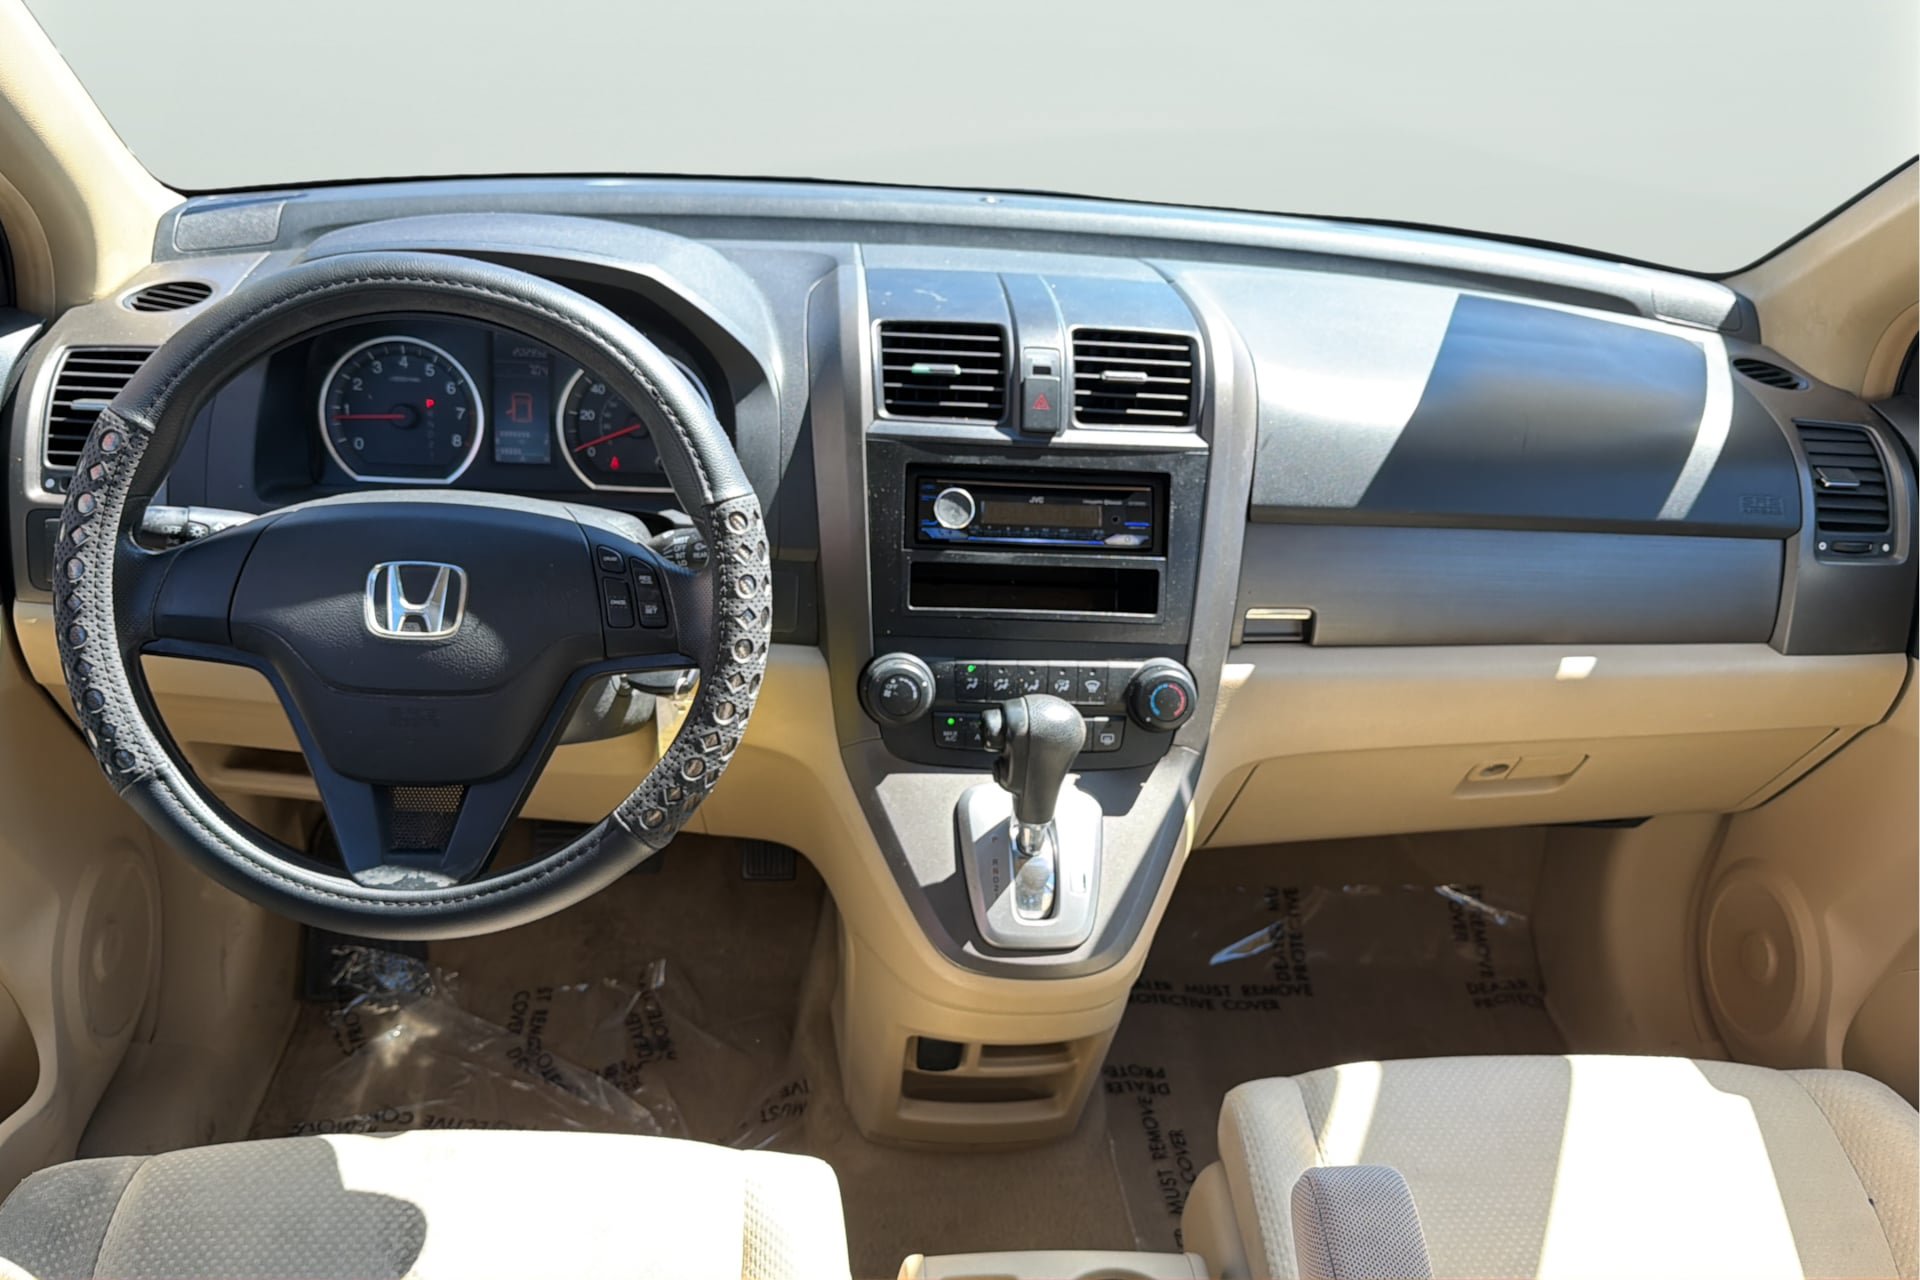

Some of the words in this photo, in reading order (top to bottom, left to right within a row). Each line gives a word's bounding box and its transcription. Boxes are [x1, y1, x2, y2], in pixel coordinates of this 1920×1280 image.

[371, 361, 382, 374] 3
[398, 356, 408, 368] 4
[424, 363, 435, 377] 5
[352, 378, 363, 391] 2
[445, 382, 457, 395] 6
[456, 407, 465, 420] 7
[580, 410, 595, 420] 20
[354, 437, 364, 450] 0
[451, 434, 462, 448] 8
[1028, 496, 1045, 504] JVC
[1184, 983, 1231, 997] MUST
[1240, 983, 1313, 998] REMOVE
[1221, 1000, 1281, 1010] COVER
[1103, 1081, 1171, 1096] DEALER
[1137, 1096, 1168, 1163] REMOVE
[1167, 1129, 1198, 1185] COVER
[1158, 1168, 1183, 1217] MUST
